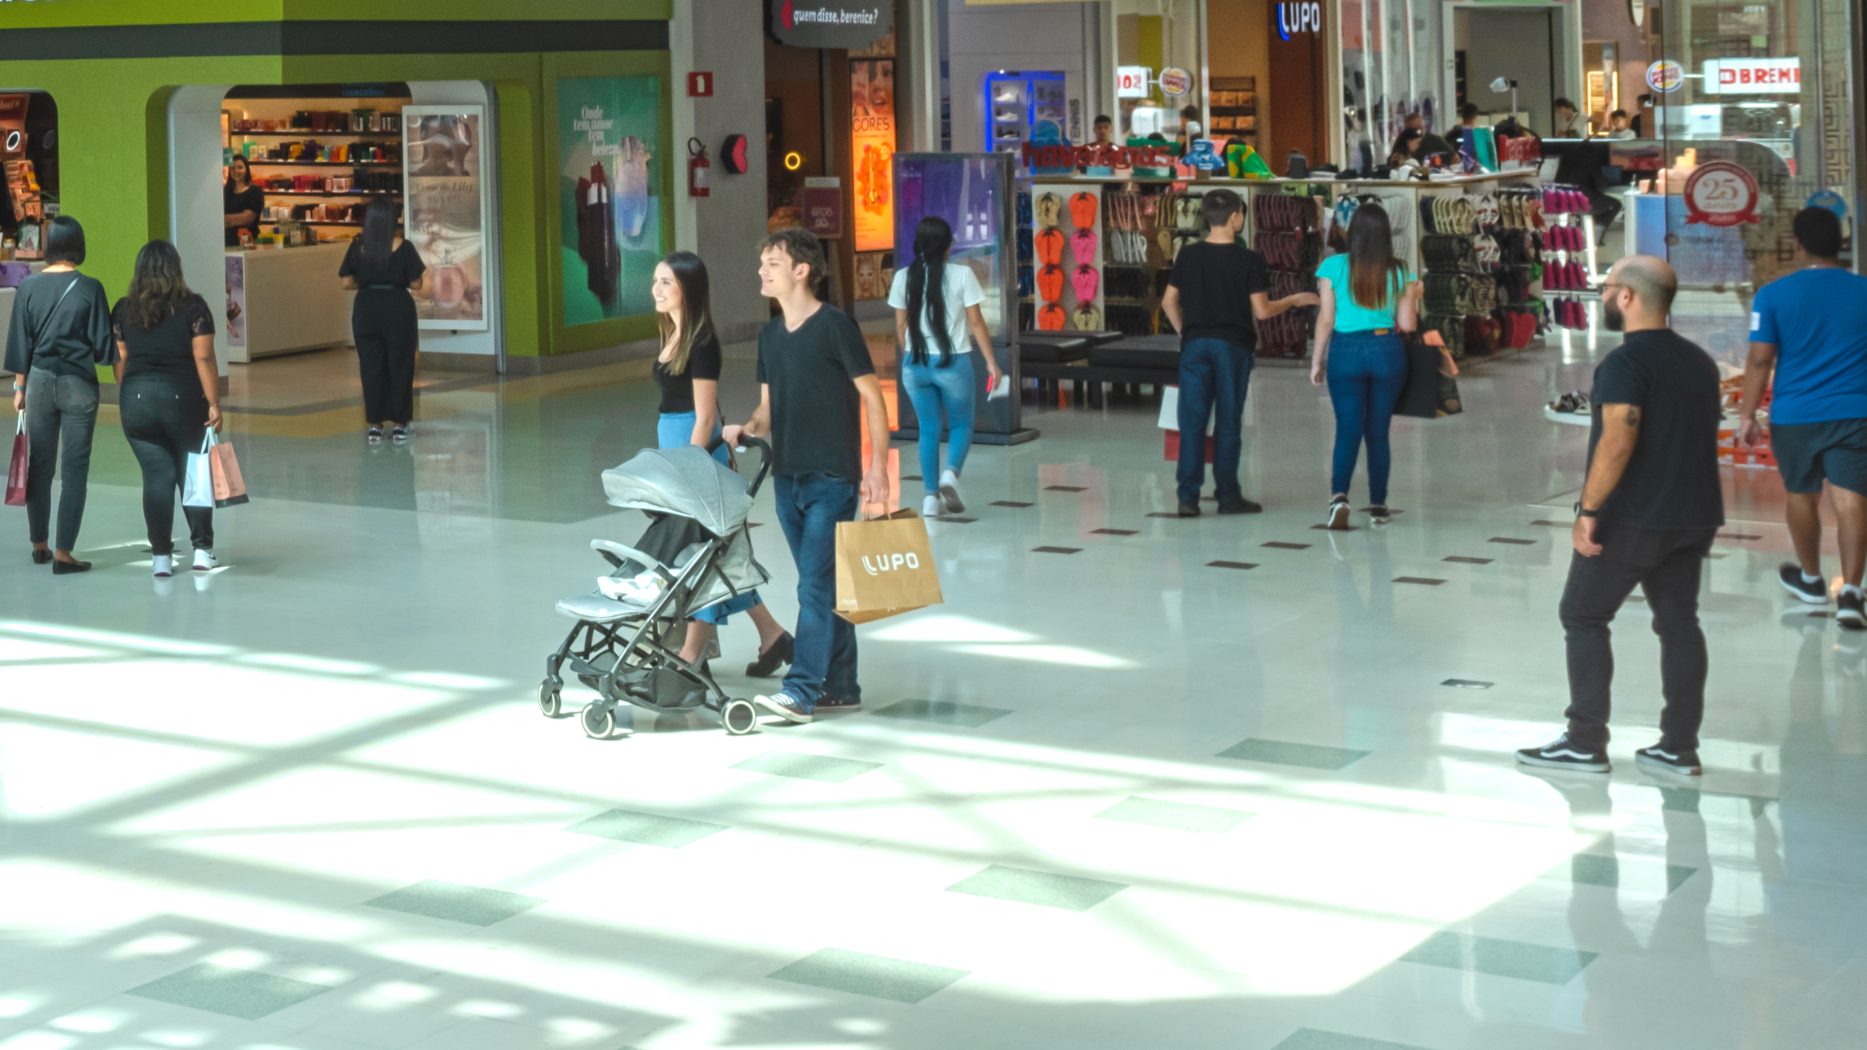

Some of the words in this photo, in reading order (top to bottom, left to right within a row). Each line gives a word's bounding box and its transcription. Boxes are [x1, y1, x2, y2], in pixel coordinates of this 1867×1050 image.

[793, 9, 817, 26] quem
[817, 7, 840, 25] disse,
[840, 8, 879, 25] berenice?
[1279, 1, 1320, 40] LUPO
[581, 104, 604, 120] Onde
[1702, 178, 1738, 200] 25
[861, 552, 920, 576] LUPO
